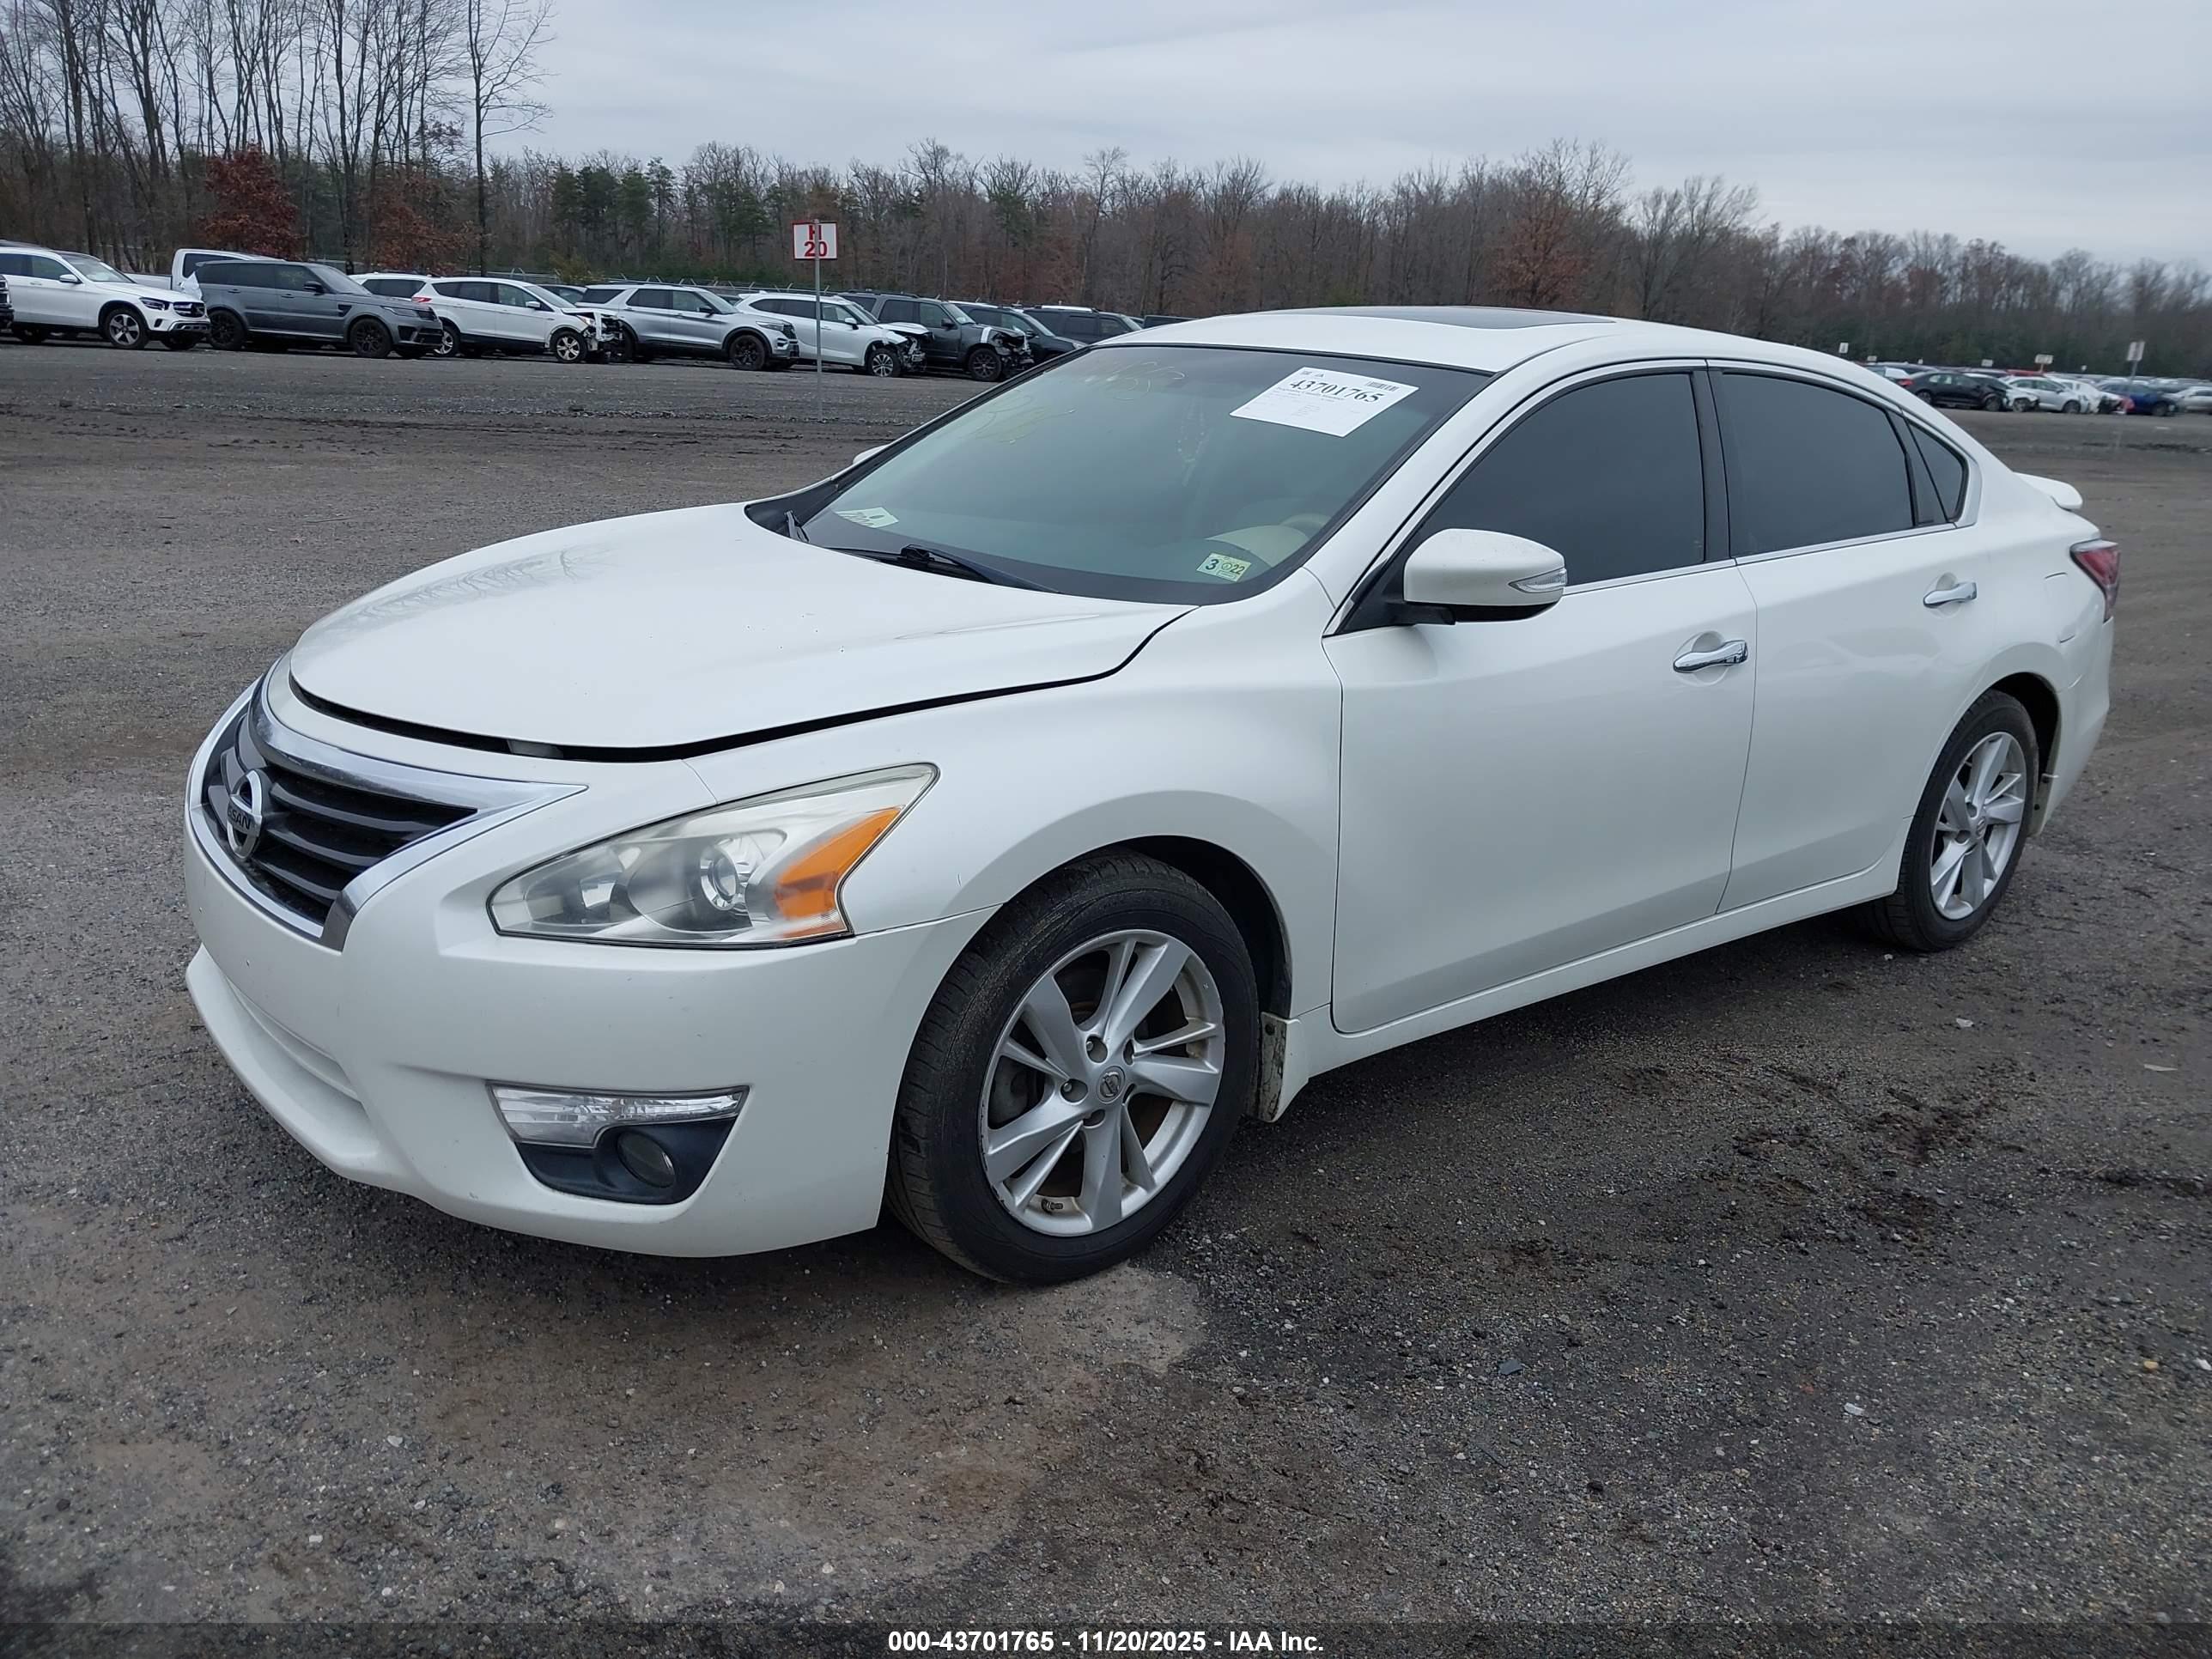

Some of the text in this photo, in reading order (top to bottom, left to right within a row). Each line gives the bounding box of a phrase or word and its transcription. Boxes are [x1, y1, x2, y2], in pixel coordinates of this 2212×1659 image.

[804, 241, 828, 257] 20
[1290, 380, 1386, 403] 43701765
[1205, 558, 1219, 570] 3
